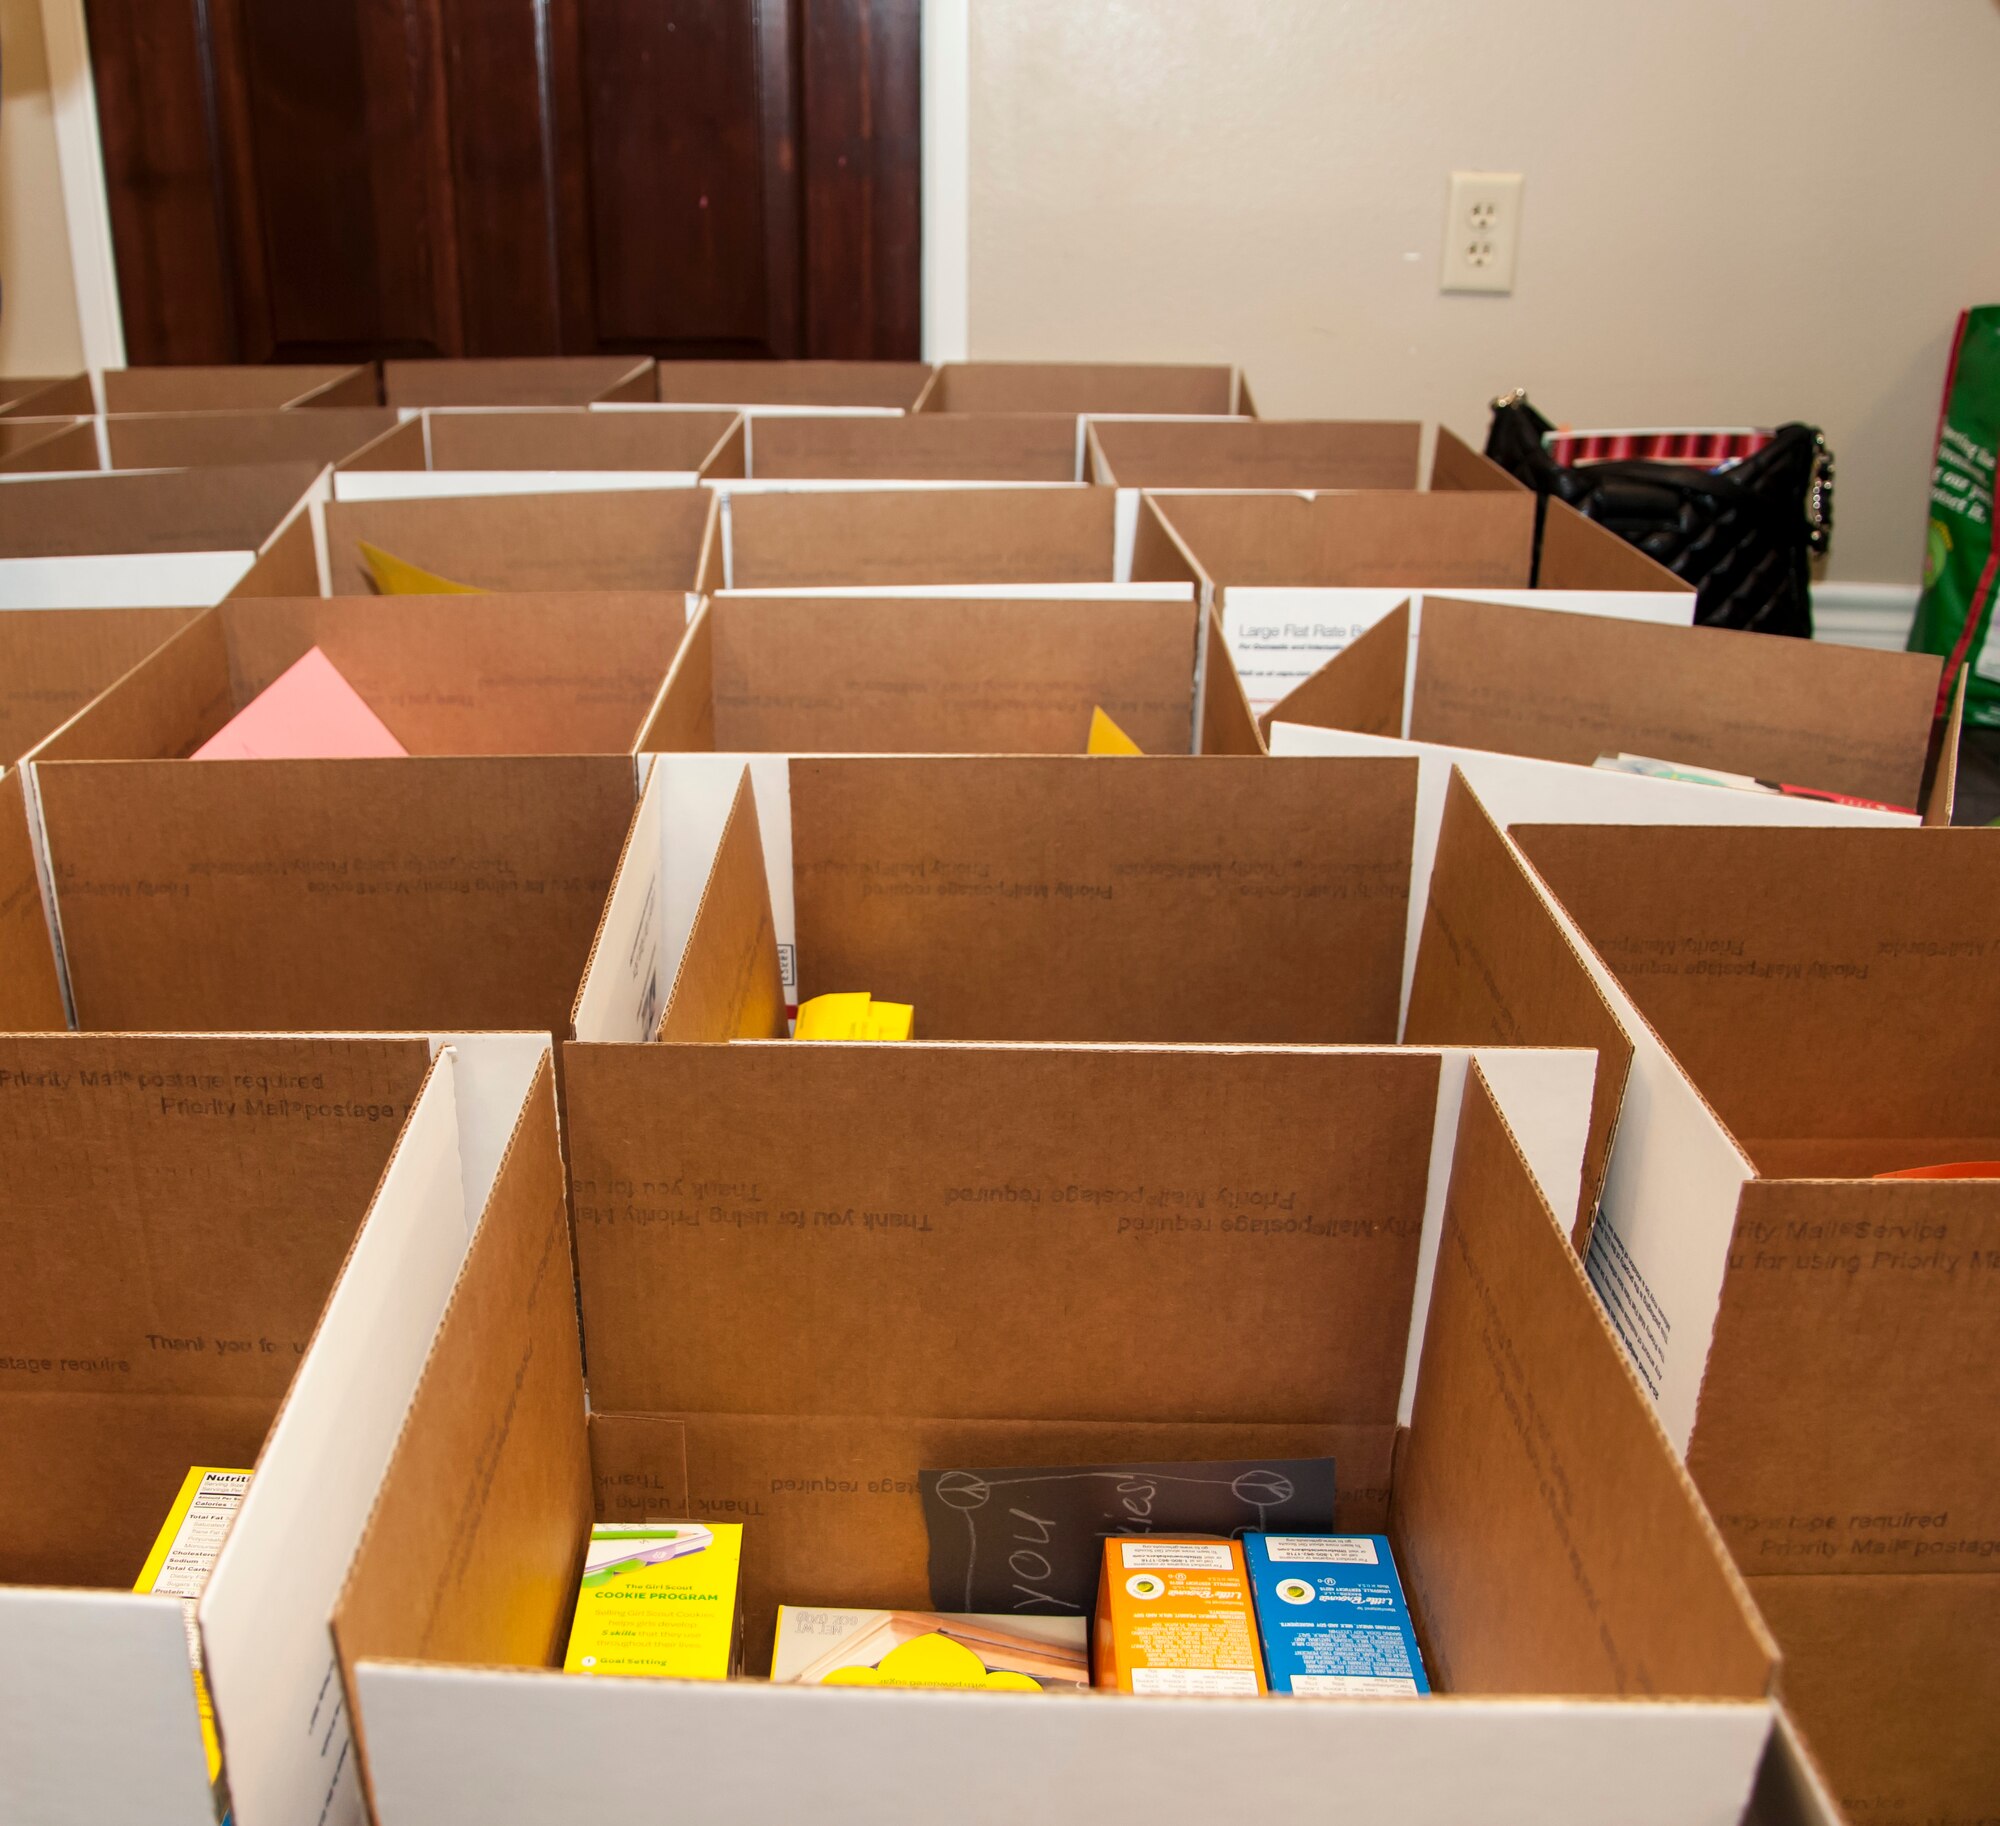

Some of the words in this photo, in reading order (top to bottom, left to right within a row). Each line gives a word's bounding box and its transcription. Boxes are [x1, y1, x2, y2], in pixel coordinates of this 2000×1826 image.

[1239, 623, 1280, 640] Large
[1283, 623, 1309, 637] Flat
[1313, 623, 1346, 637] Rate
[234, 1071, 324, 1091] required
[160, 1097, 236, 1117] Priority
[305, 1101, 394, 1122] postage
[779, 1211, 805, 1229] for
[814, 1208, 855, 1228] you
[0, 1356, 53, 1374] stage
[206, 1474, 250, 1483] Nutriti
[771, 1476, 858, 1495] required
[595, 1591, 646, 1599] COOKIE
[650, 1592, 718, 1601] PROGRAM
[596, 1640, 652, 1648] throughout
[627, 1658, 668, 1667] Setting
